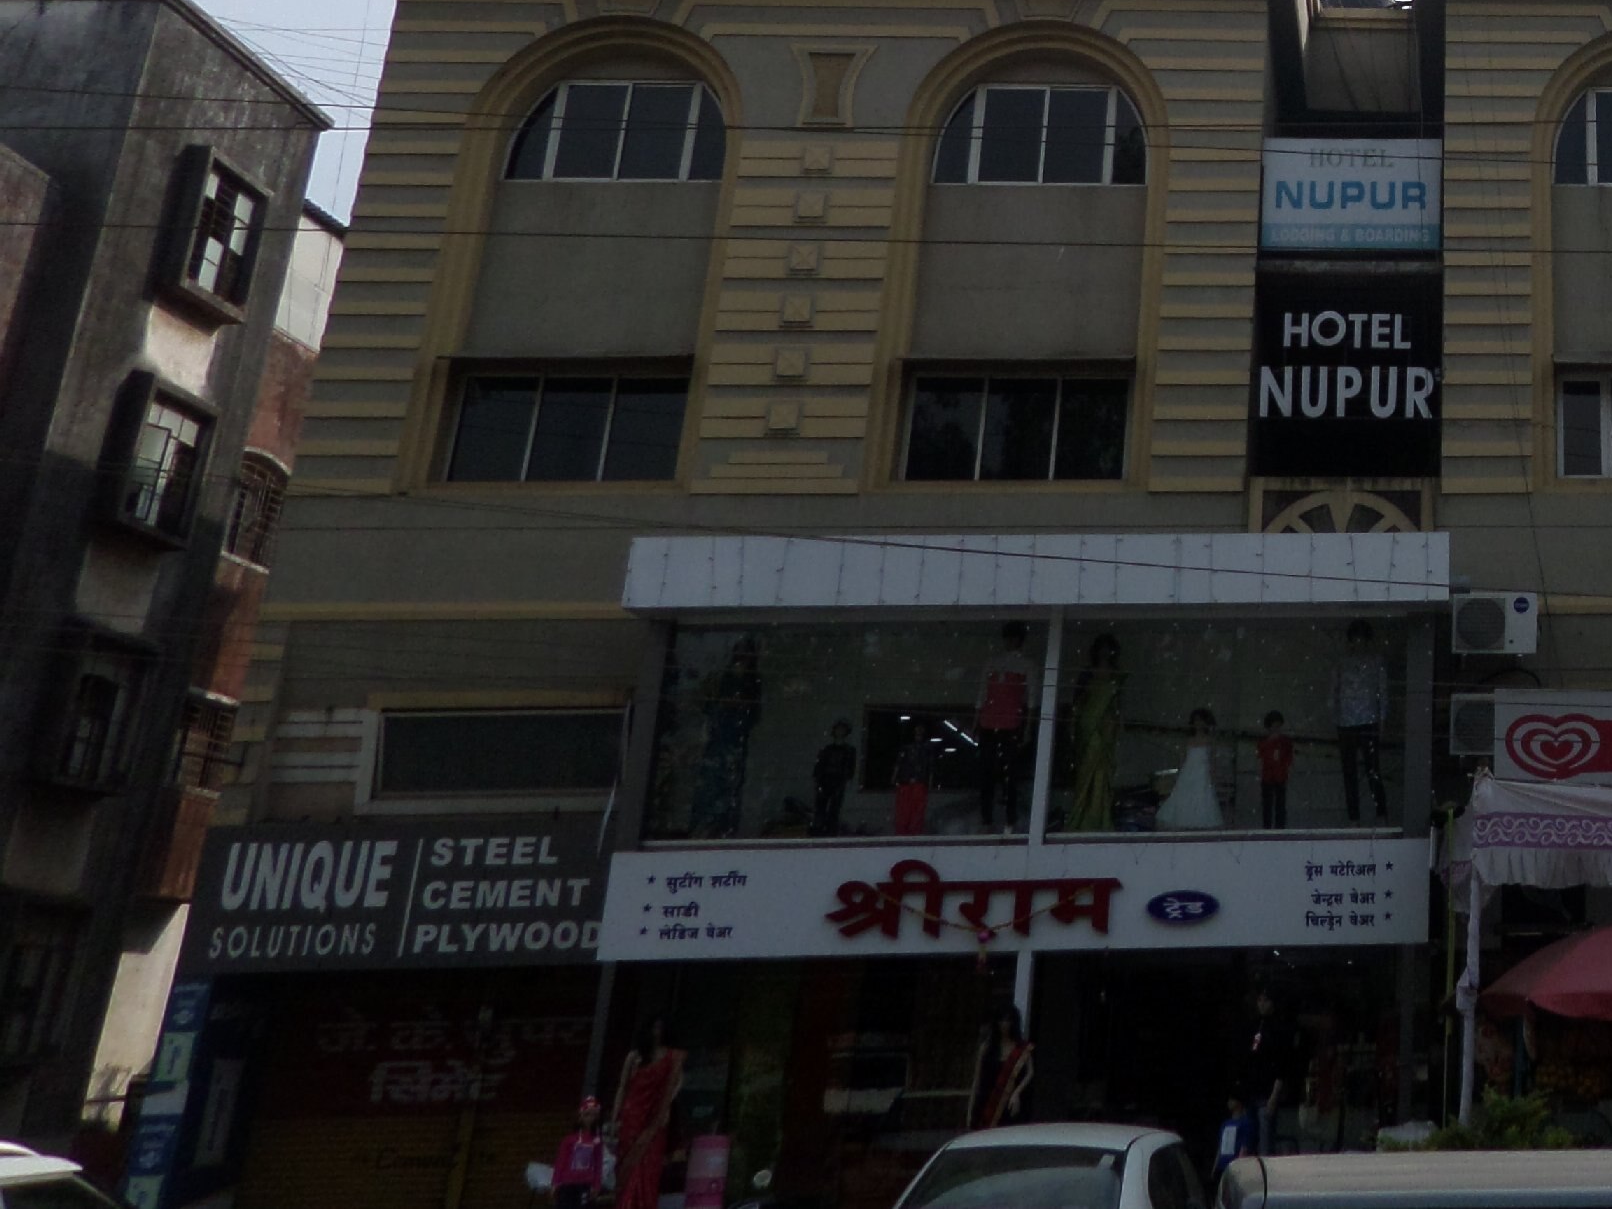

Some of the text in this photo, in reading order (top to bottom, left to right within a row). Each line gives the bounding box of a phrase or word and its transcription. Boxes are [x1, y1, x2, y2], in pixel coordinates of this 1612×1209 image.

[1309, 148, 1394, 168] HOTEL
[1275, 180, 1427, 210] NUPUR
[1271, 228, 1430, 242] LODGING & BOARDING
[1282, 310, 1412, 350] HOTEL
[1258, 365, 1435, 420] NUPUR
[430, 835, 559, 866] STEEL
[221, 840, 400, 913] UNIQUE
[421, 877, 592, 909] CEMENT
[826, 859, 1123, 939] श्रीराम
[208, 922, 378, 960] SOLUTIONS
[412, 920, 602, 955] PLYWOOD
